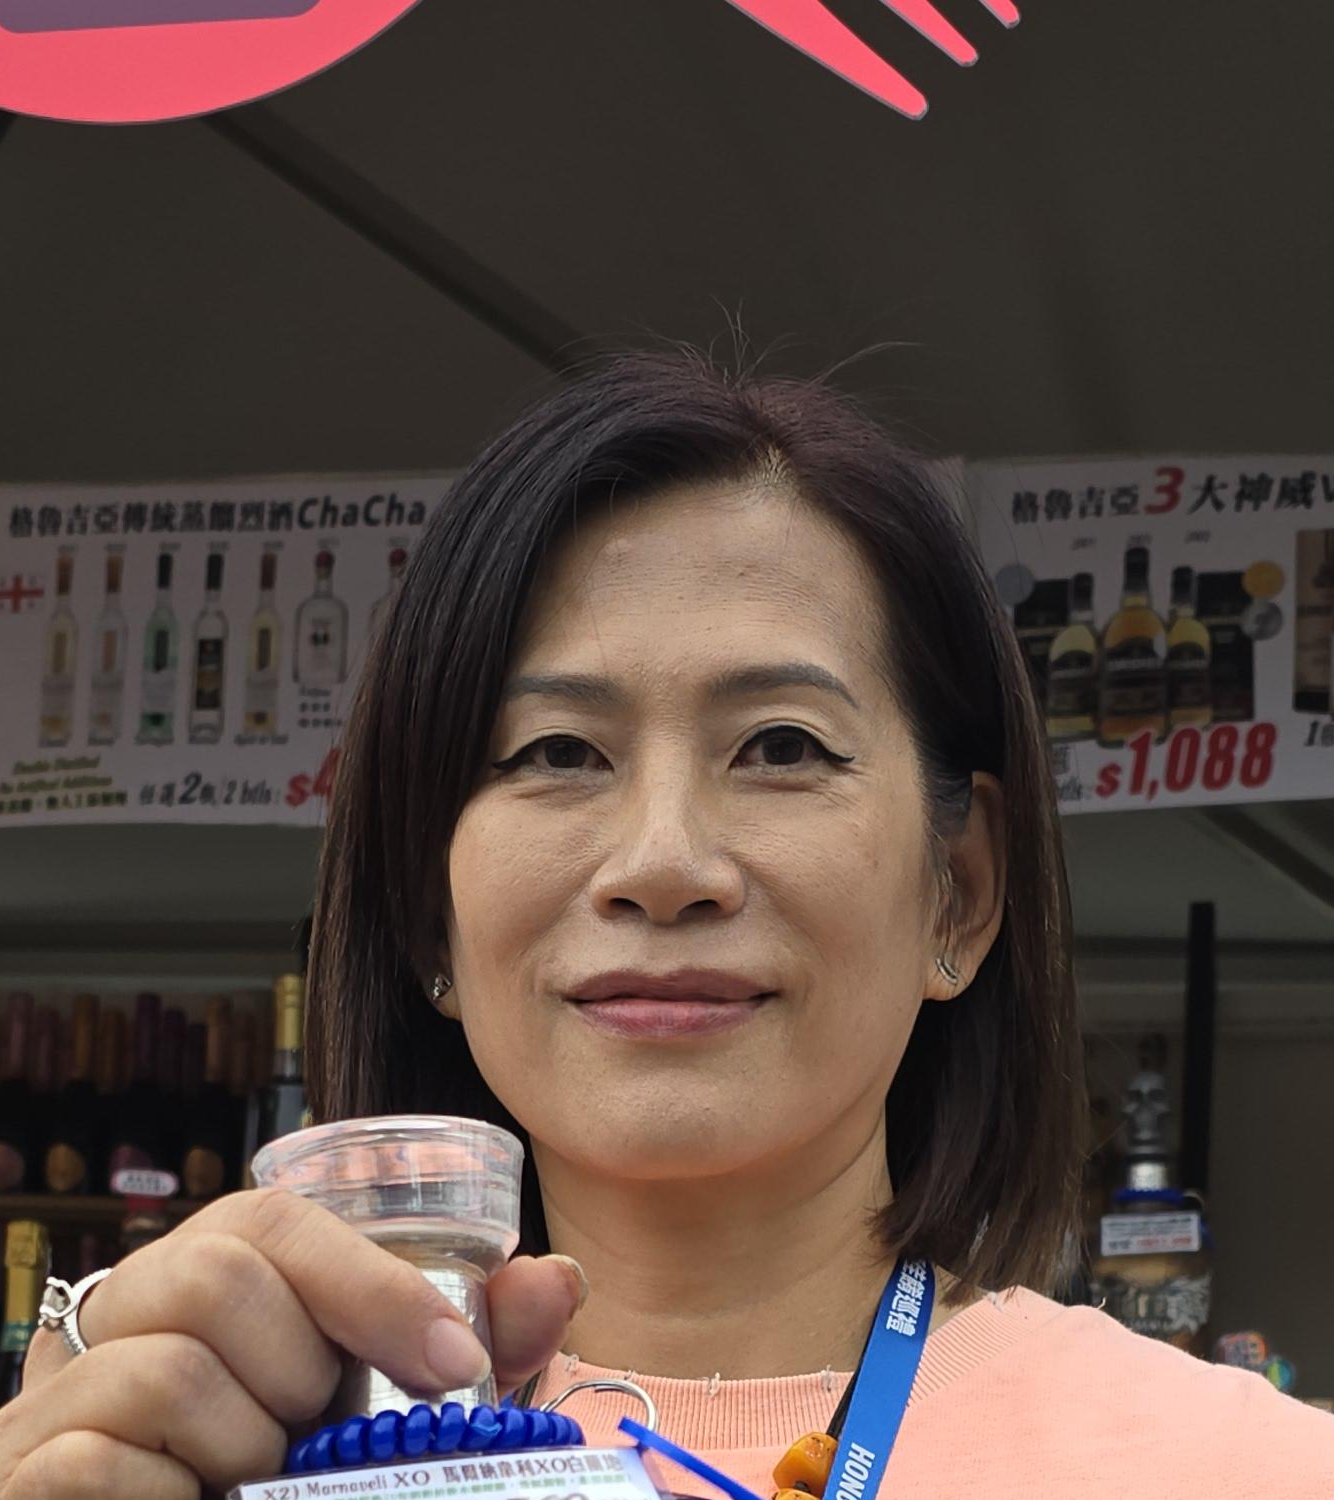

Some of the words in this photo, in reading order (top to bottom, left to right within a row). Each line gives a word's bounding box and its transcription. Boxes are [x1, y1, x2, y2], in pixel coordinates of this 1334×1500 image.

[1095, 719, 1279, 801] $1,088
[305, 1475, 388, 1499] Marnaveli
[393, 1470, 431, 1488] XO
